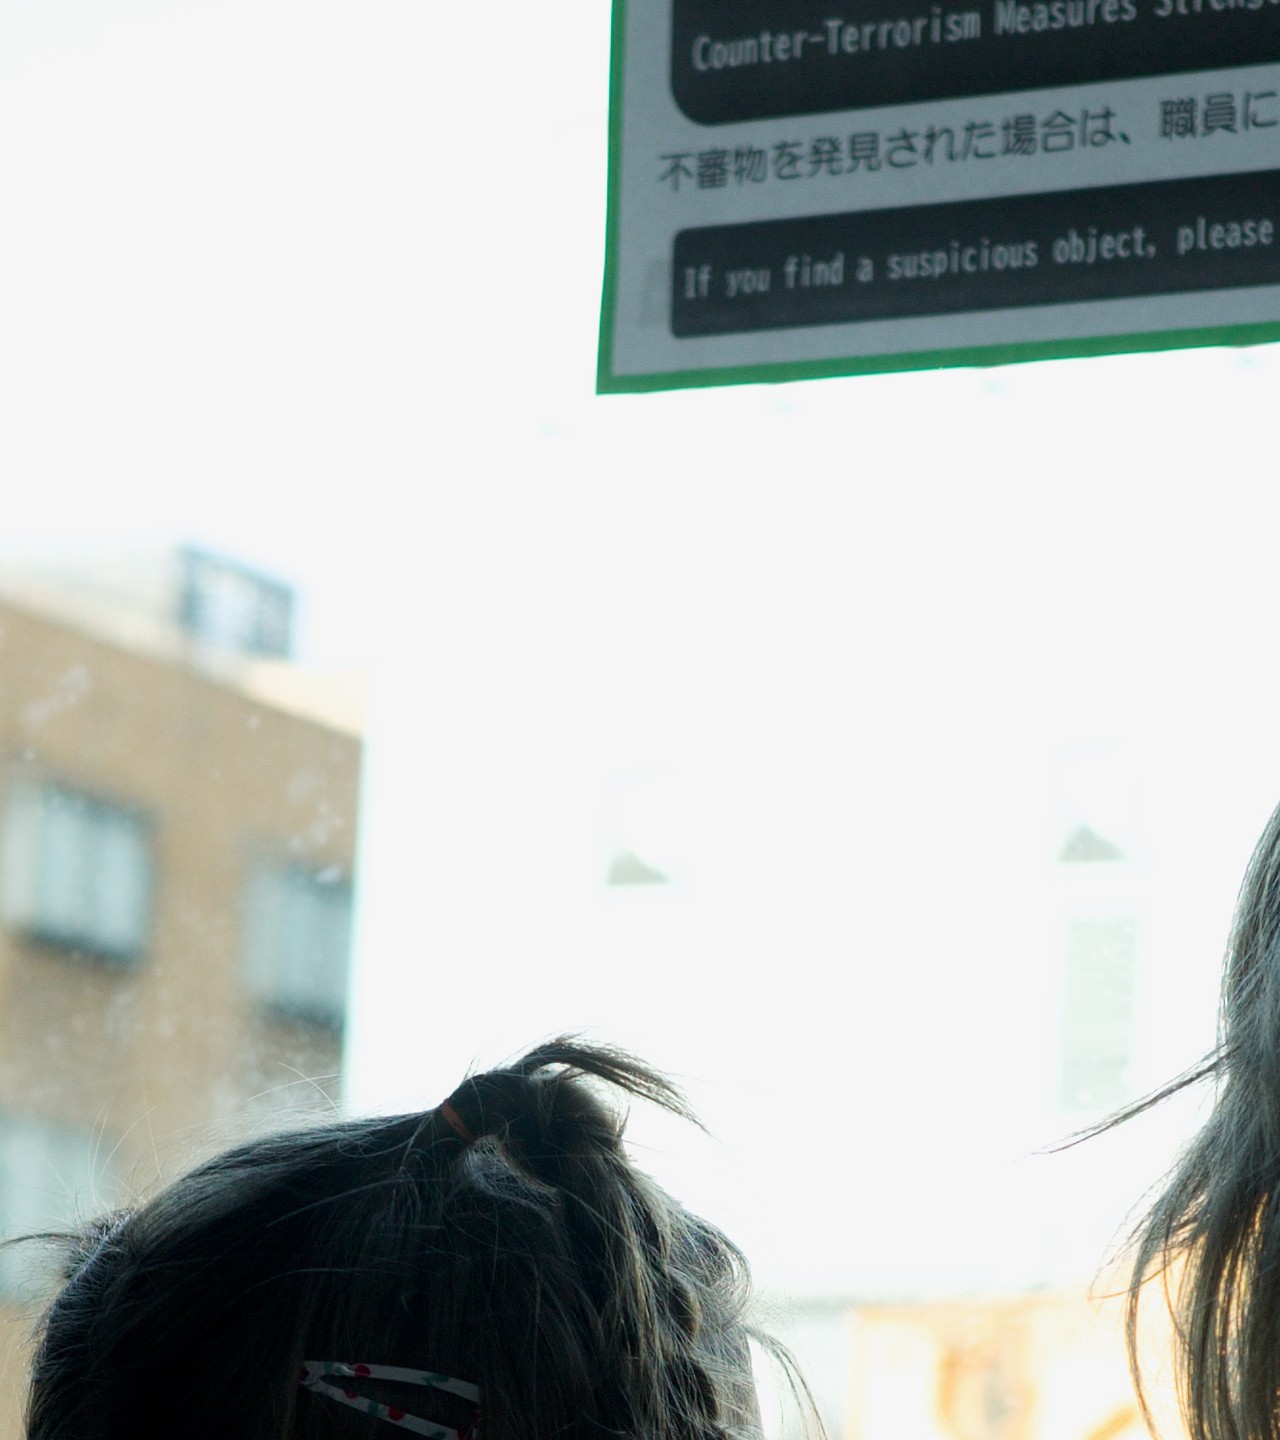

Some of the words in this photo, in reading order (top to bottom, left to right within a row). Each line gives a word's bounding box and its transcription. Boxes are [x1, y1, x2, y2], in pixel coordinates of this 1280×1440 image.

[691, 4, 981, 73] Counter-Terrorism
[683, 264, 713, 300] If
[725, 266, 772, 302] you
[786, 250, 846, 292] find
[857, 258, 874, 284] a
[887, 235, 1039, 284] suspicious
[1053, 219, 1158, 268] object,
[1177, 209, 1275, 260] please
